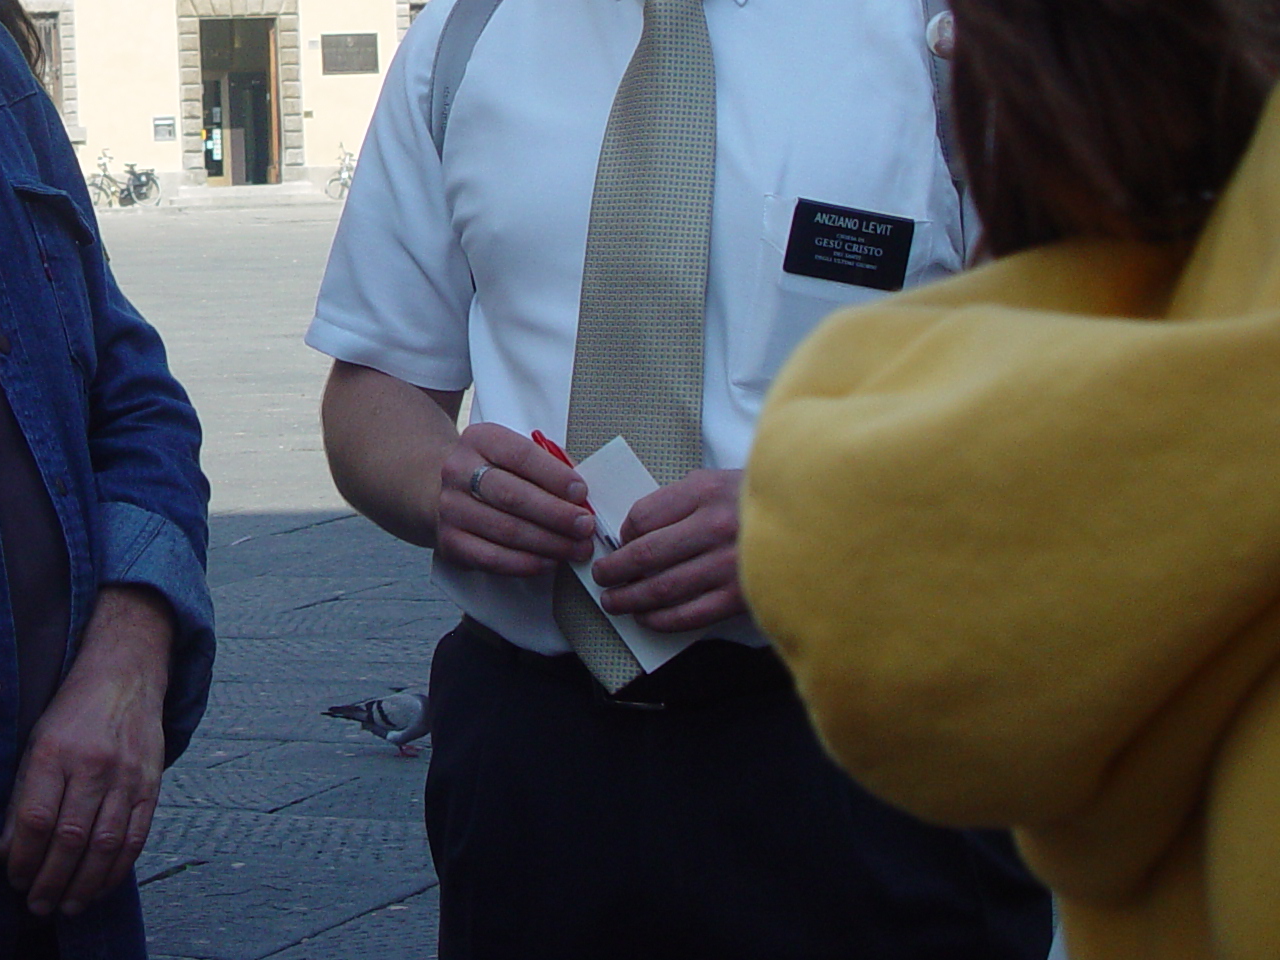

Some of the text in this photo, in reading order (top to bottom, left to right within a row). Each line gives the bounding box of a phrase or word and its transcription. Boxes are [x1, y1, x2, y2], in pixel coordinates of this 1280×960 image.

[814, 212, 893, 236] ANZIANO LEVIT
[845, 243, 883, 257] CRISTO
